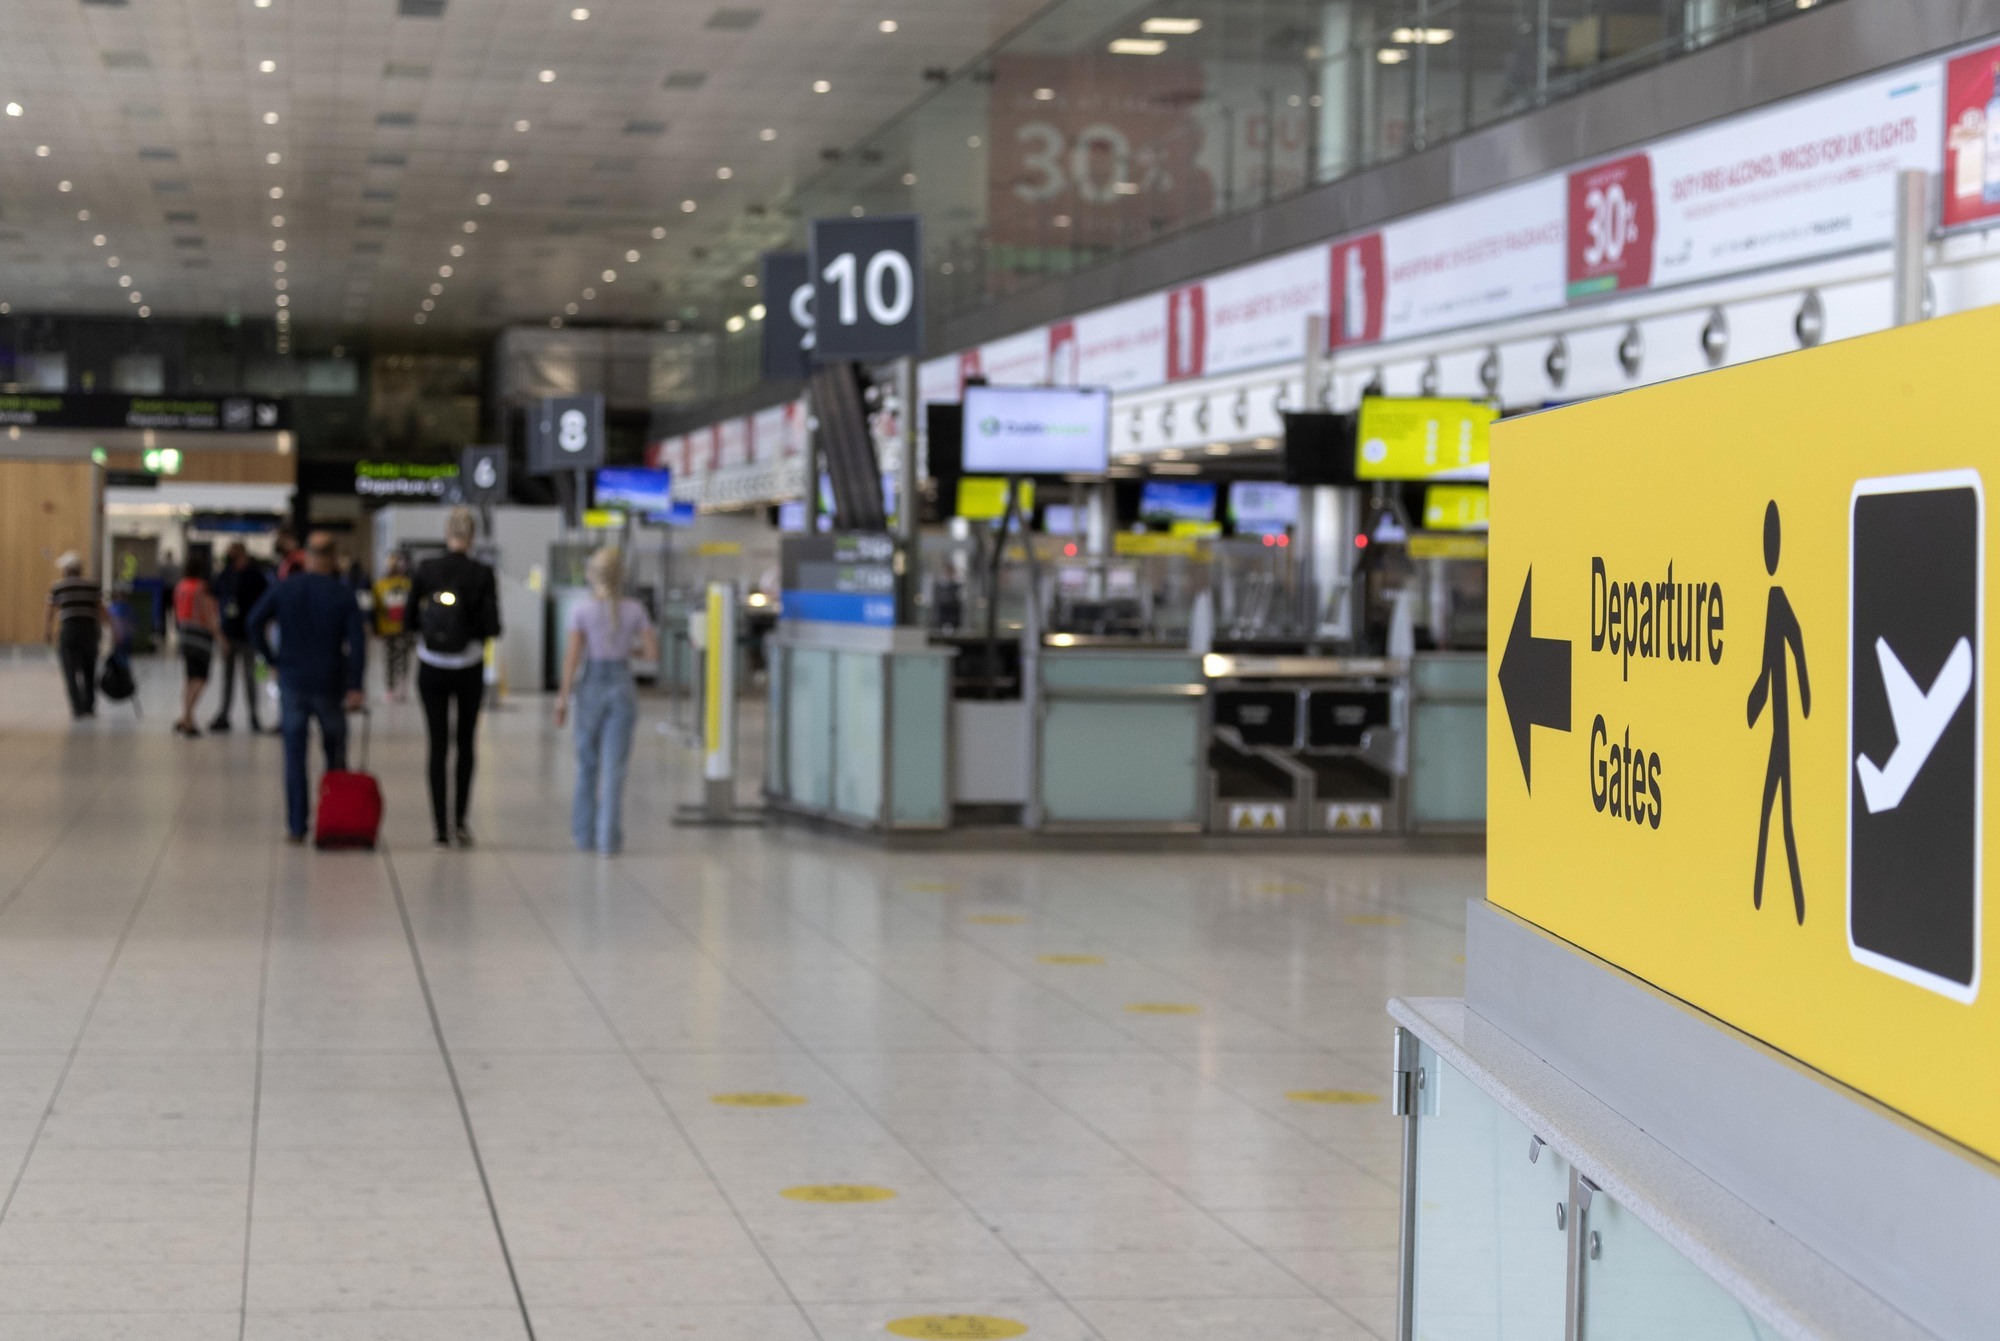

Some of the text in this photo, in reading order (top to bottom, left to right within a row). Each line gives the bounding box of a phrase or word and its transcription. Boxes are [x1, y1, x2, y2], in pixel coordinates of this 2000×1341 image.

[1671, 173, 1700, 203] DUTY
[1727, 153, 1777, 187] ALCOHOL
[1779, 140, 1820, 172] PRICES
[1822, 134, 1846, 163] FOR
[1866, 115, 1917, 151] FLIGHTS
[1583, 184, 1639, 265] 30%
[823, 249, 914, 326] 10
[559, 409, 589, 452] 8
[473, 456, 496, 489] 6
[1591, 556, 1725, 682] Departure
[1590, 713, 1662, 830] Gates
